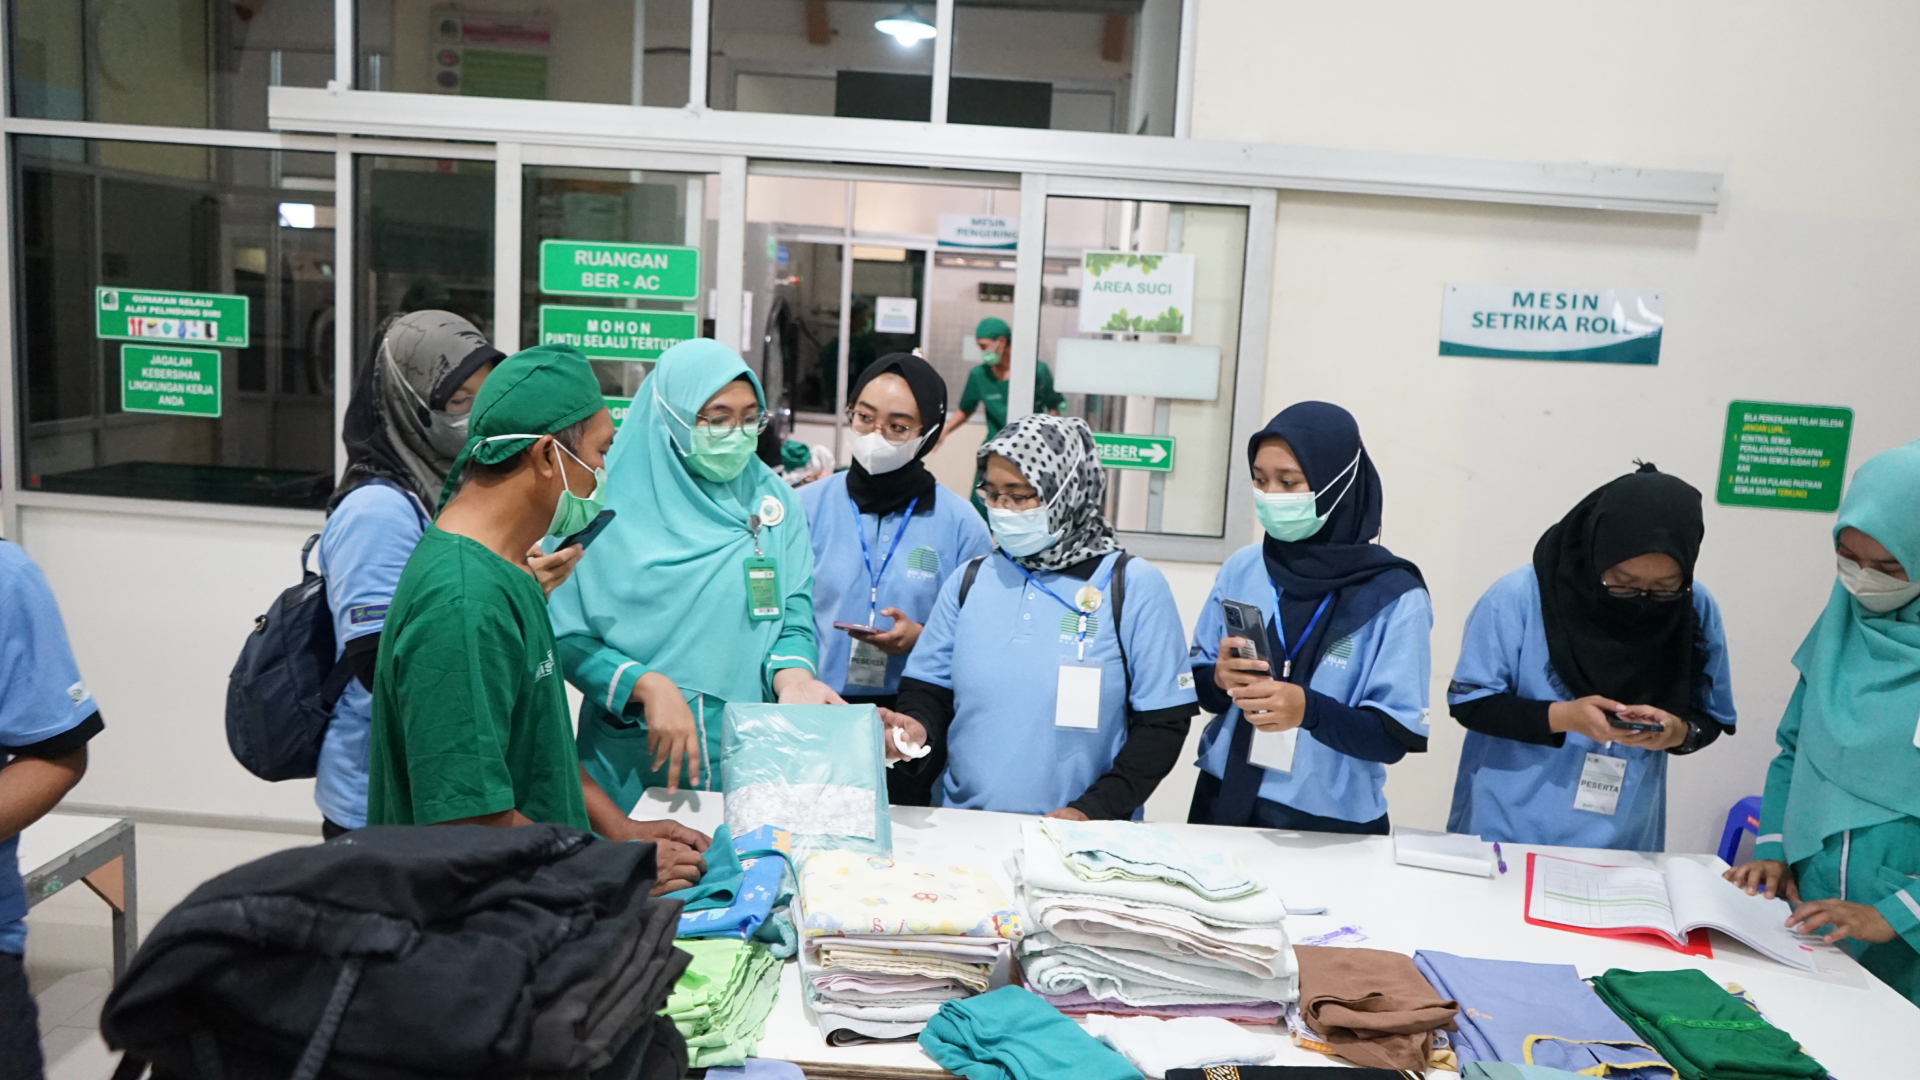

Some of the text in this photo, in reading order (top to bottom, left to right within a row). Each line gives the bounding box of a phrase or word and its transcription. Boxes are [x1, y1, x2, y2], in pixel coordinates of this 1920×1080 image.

[971, 218, 1006, 228] MESIN
[574, 250, 668, 269] RUANGAN
[581, 272, 619, 288] BER
[633, 275, 660, 290] AC
[1093, 281, 1172, 295] AREA SUCI
[132, 294, 213, 307] GUNAKAN SELALU
[1512, 291, 1599, 310] MESIN
[124, 305, 222, 318] ALAT PELINDUNG DIRI
[587, 319, 651, 335] MOHON
[1471, 311, 1568, 332] SETRIKA
[545, 332, 682, 351] PINTU SELALU TERTUT
[150, 354, 193, 367] JAGALAH
[141, 367, 201, 381] KEBERSIHAN
[128, 380, 214, 395] LINGKUNGAN KERJA
[158, 395, 185, 406] ANDA
[1743, 412, 1758, 422] BILA
[1096, 443, 1138, 458] GESER
[1581, 779, 1619, 793] PESERTA
